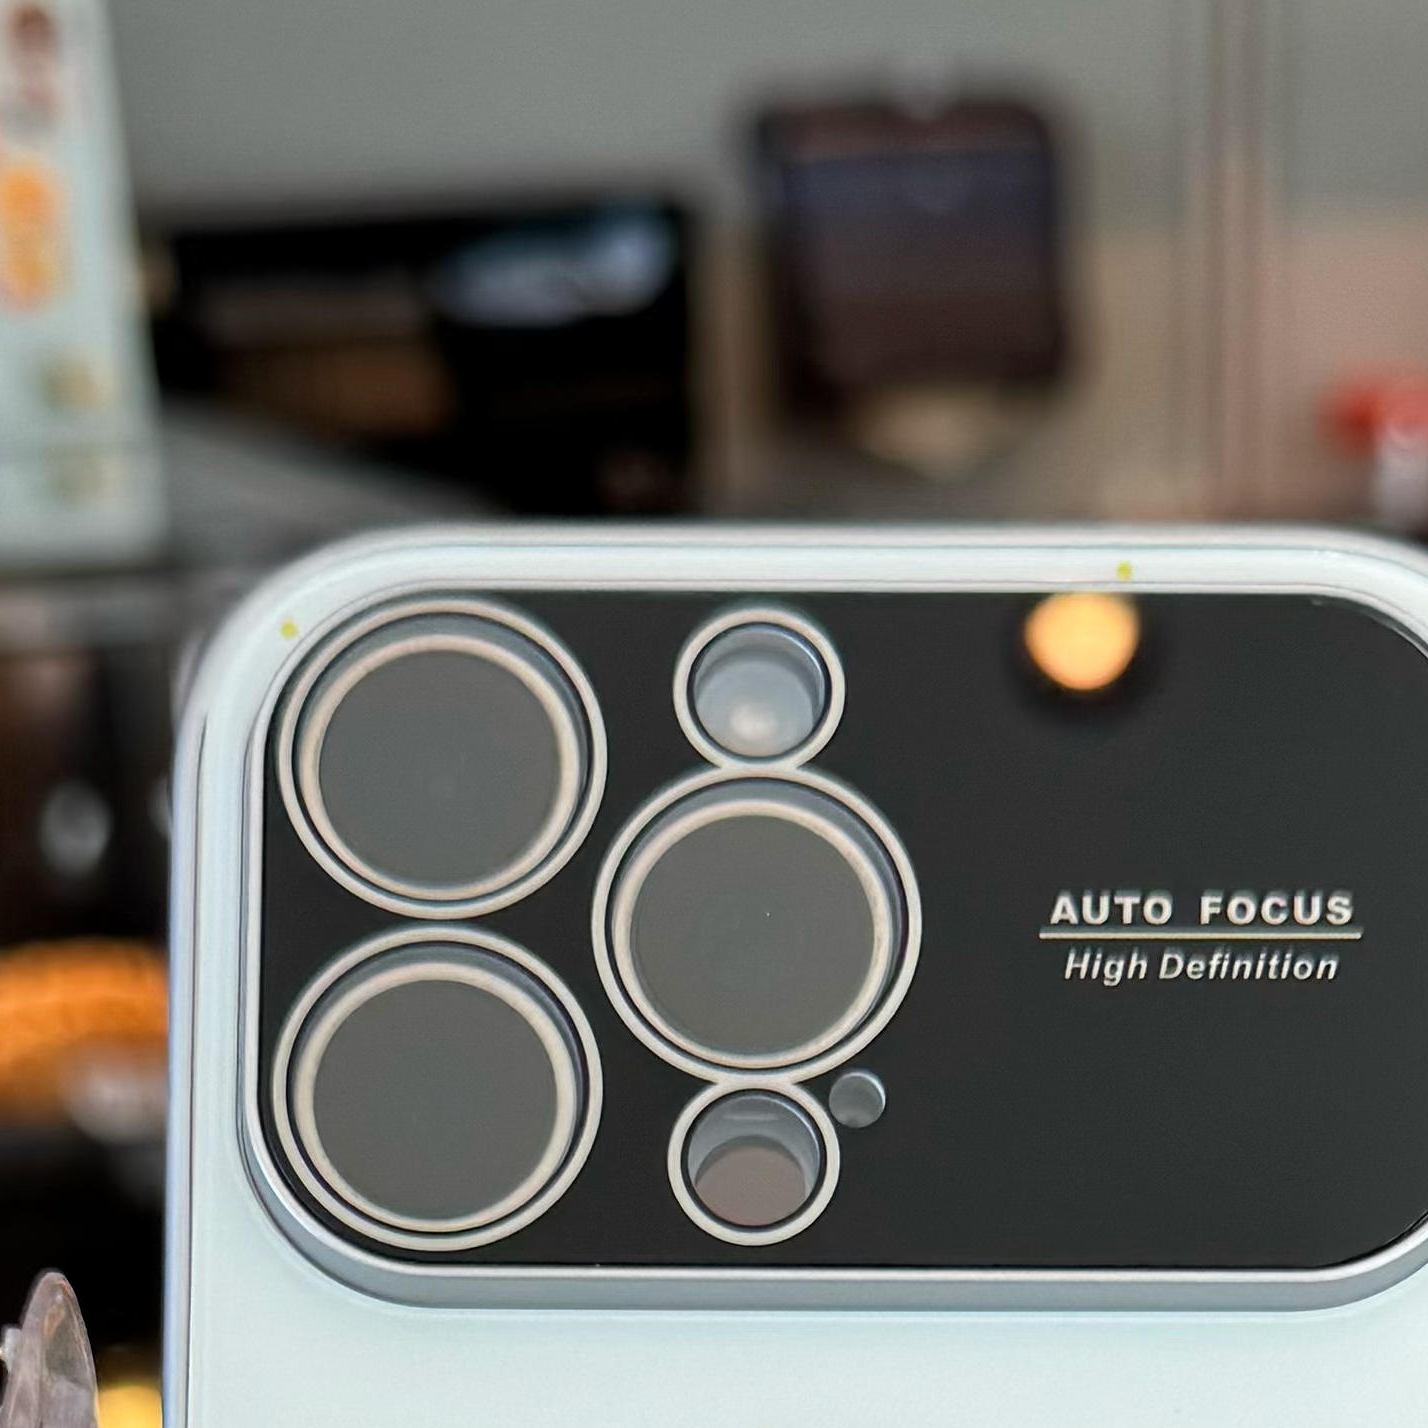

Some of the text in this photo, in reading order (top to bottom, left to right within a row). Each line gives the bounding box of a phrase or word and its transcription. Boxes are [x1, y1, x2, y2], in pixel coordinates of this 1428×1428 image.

[1049, 891, 1355, 926] AUTO FOCUS
[1063, 947, 1340, 988] High Definition
